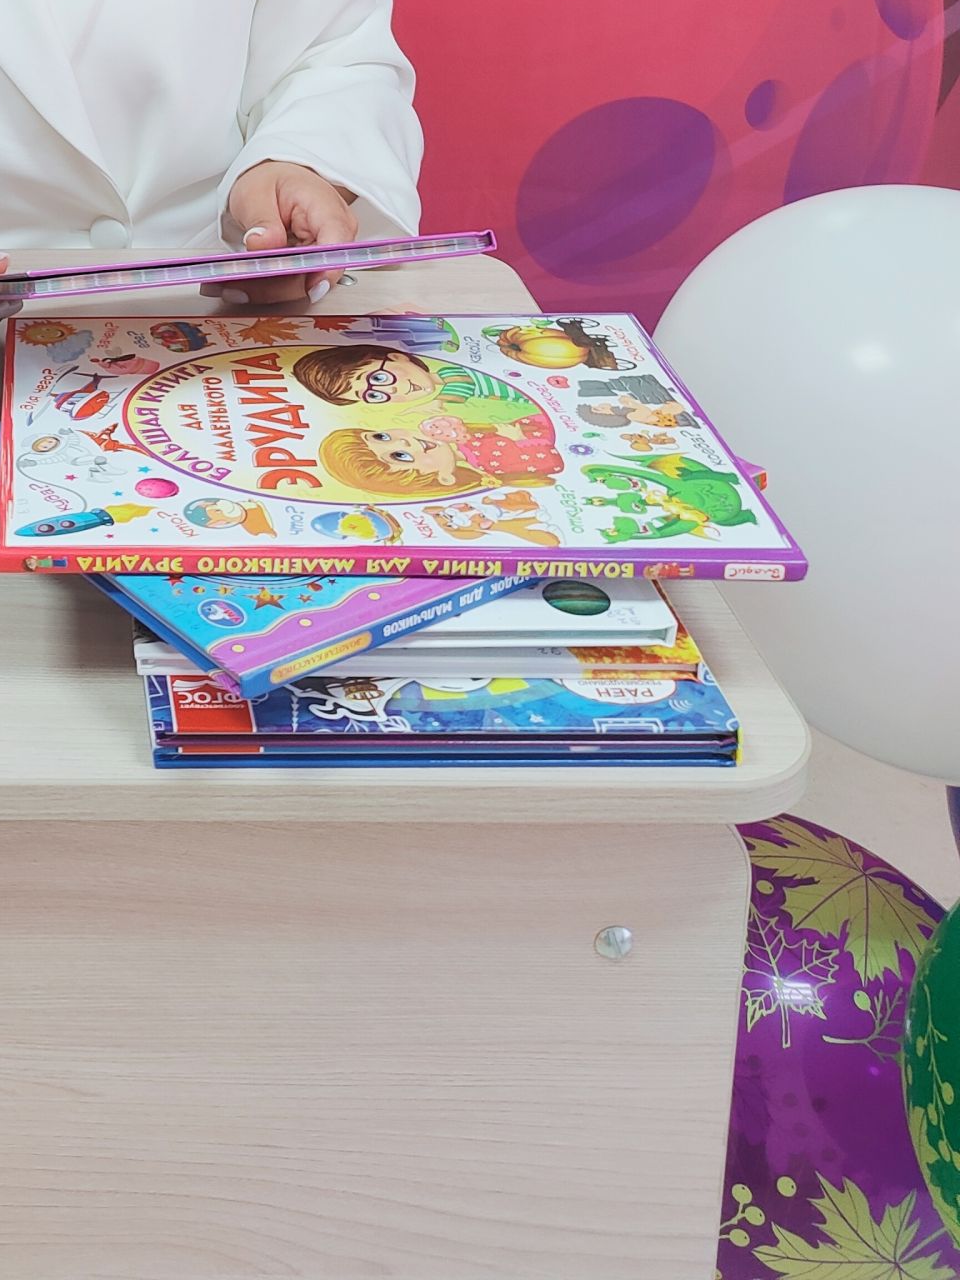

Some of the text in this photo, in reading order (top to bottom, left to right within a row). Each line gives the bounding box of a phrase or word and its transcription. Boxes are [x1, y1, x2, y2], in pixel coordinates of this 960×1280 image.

[133, 363, 233, 482] БОЛЬШАЯ КНИГА
[177, 403, 204, 431] ДЛЯ
[202, 375, 238, 462] МАЛЕНЬКОГО
[229, 352, 324, 491] ЭРУДИТА
[28, 482, 73, 512] куда?
[156, 510, 201, 538] кто?
[284, 505, 304, 536] что?
[402, 510, 435, 539] как?
[76, 553, 636, 578] БОЛЬШАЯ КНИГА ДЛЯ МАЛЕНЬКОГО ЭРУДИТА
[458, 584, 486, 608] ДЛЯ
[382, 601, 454, 638] МАЛЬЧИКОВ
[177, 690, 241, 704] ФГОС
[596, 687, 654, 698] РАЕН
